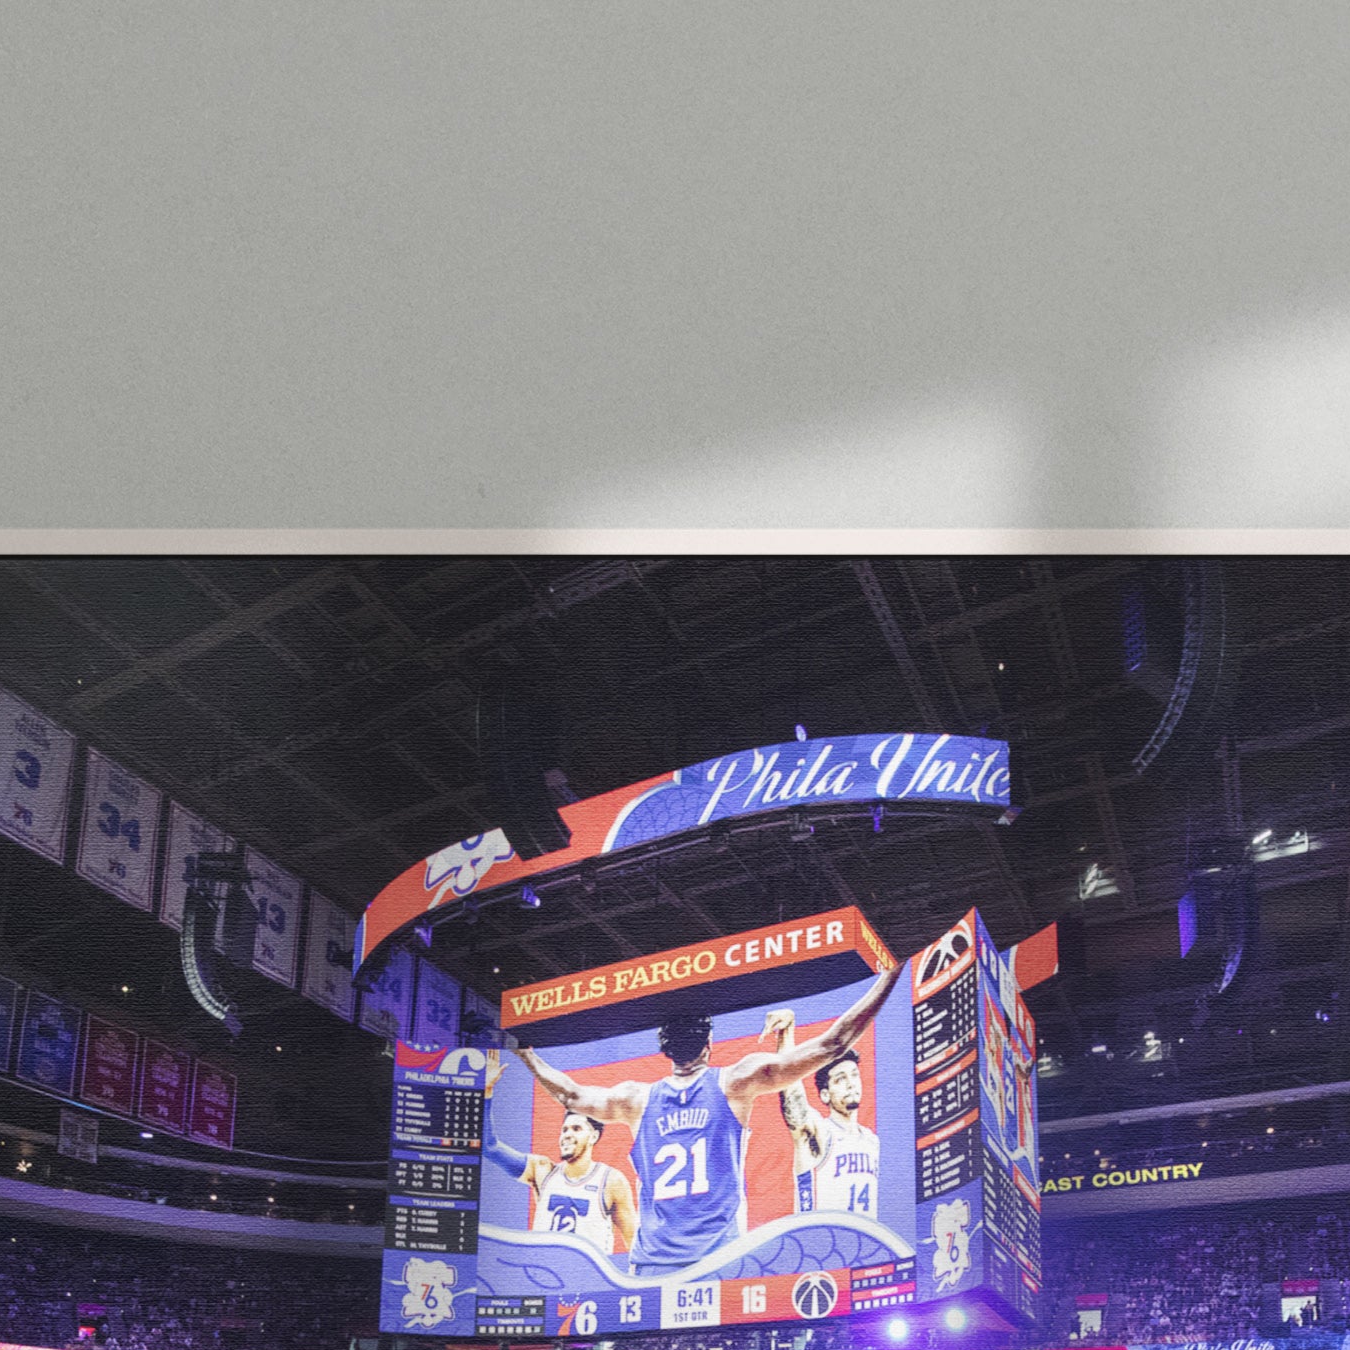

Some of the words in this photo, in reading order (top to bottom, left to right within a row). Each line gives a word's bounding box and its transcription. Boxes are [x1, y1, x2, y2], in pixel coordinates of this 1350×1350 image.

[15, 749, 41, 790] 3
[697, 744, 858, 826] Phila
[869, 732, 1011, 803] Unite
[97, 801, 141, 853] 34
[510, 975, 608, 1017] WELLS
[612, 949, 717, 1004] FARGO
[723, 919, 845, 967] CENTER
[655, 1107, 710, 1137] EMBIID
[653, 1137, 710, 1202] 21
[834, 1151, 879, 1178] PHIL
[1092, 1162, 1205, 1189] COUNTRY
[847, 1182, 870, 1212] 14
[618, 1295, 642, 1324] 13
[676, 1286, 714, 1308] 6:41
[741, 1284, 767, 1314] 16
[556, 1303, 599, 1337] 76
[673, 1310, 689, 1322] 1ST
